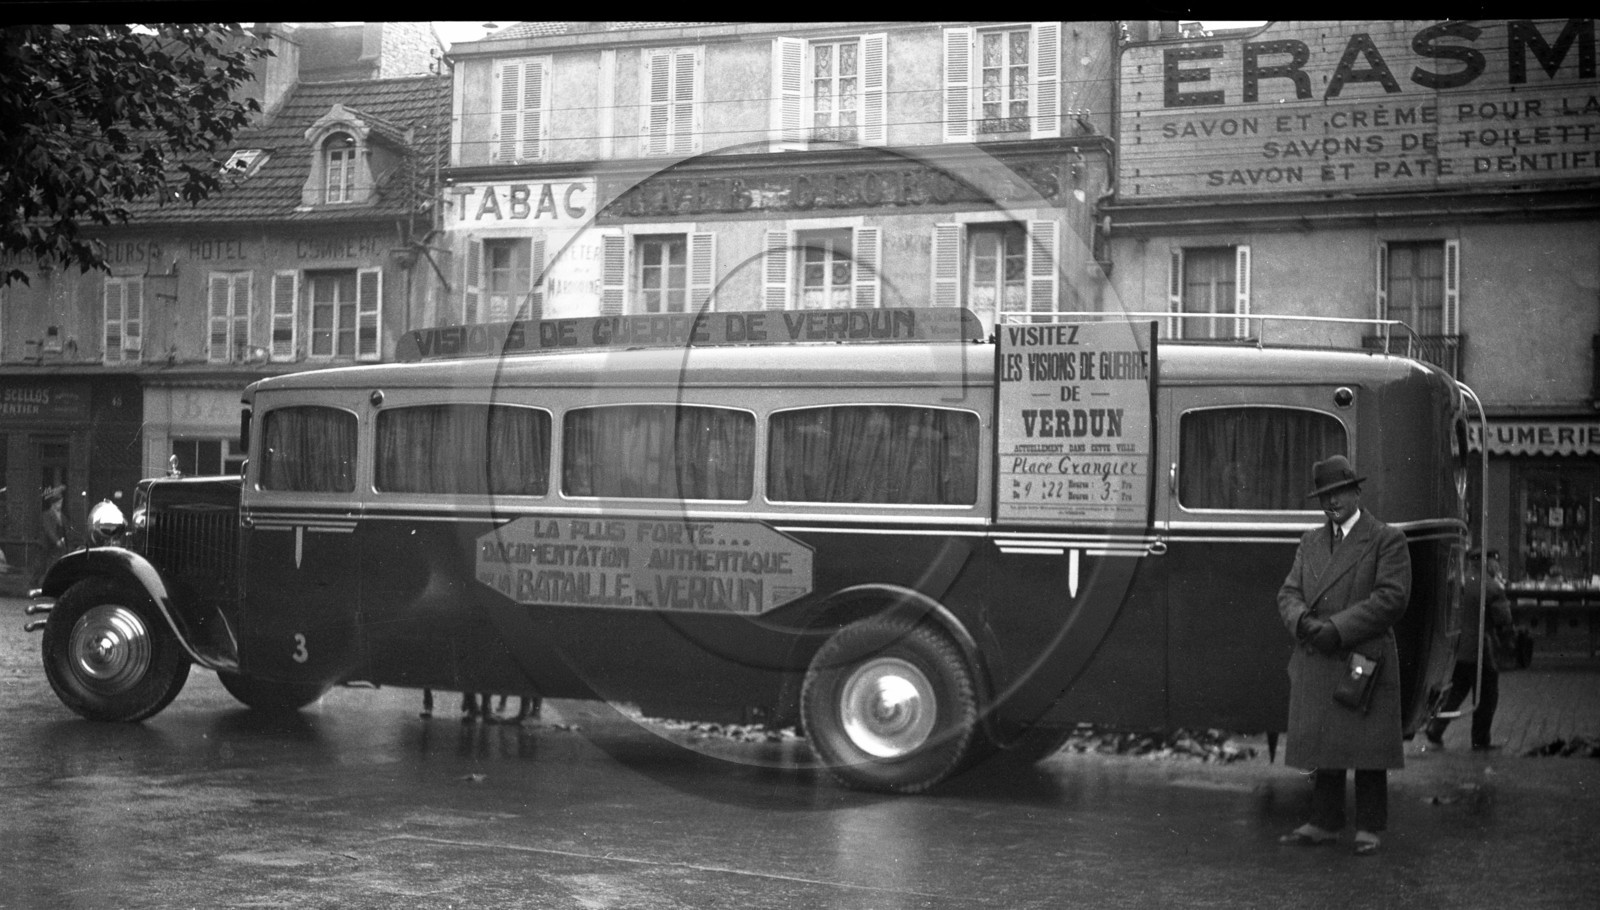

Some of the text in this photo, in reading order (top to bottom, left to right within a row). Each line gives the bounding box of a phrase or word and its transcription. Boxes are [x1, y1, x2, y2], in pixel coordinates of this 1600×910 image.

[1163, 19, 1596, 108] ERASM
[1162, 96, 1600, 139] SAVON ET CRÈME POUR LA
[1262, 124, 1596, 159] SAVONS DE TOILETT
[1208, 166, 1303, 188] SAVON
[1321, 163, 1355, 182] ET
[452, 182, 588, 222] TABAC
[414, 321, 526, 357] VISIONS
[539, 319, 578, 347] DE
[592, 315, 711, 346] GUERRE
[725, 313, 767, 343] DE
[783, 308, 916, 341] VERDUN
[1009, 325, 1080, 347] VISITEZ
[1001, 350, 1149, 382] LES VISIONS DE GUERRE
[1060, 385, 1081, 402] DE
[1021, 408, 1124, 438] VERDUN
[1012, 457, 1053, 475] Place
[533, 519, 561, 540] LA
[570, 520, 626, 542] PLUS
[647, 549, 794, 575] AUTHENTIQUE
[515, 569, 633, 607] BATAILLE
[653, 573, 764, 613] VERDUN
[291, 631, 309, 664] 3
